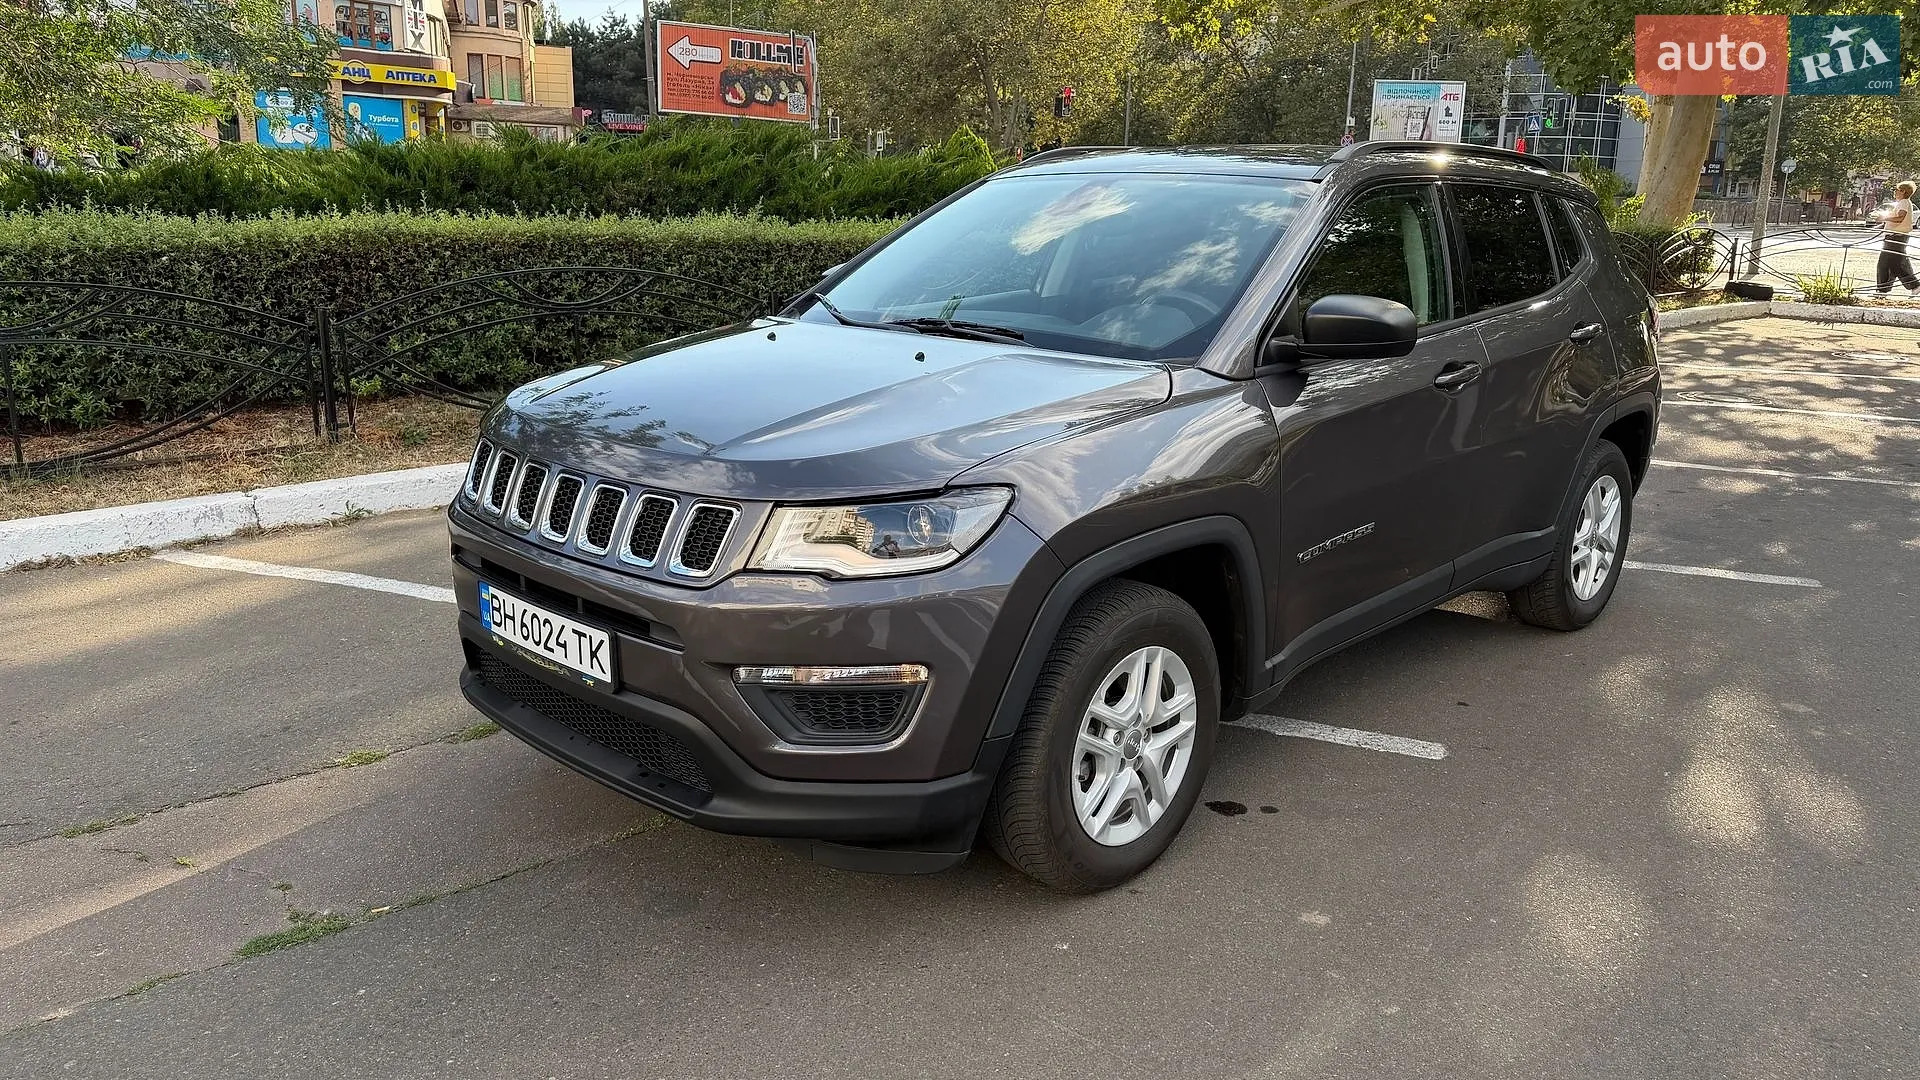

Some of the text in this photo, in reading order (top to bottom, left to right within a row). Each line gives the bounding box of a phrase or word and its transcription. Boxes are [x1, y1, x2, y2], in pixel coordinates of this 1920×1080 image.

[678, 47, 698, 57] 280
[341, 66, 437, 84] АНЦ АПТЕКА
[1440, 93, 1461, 101] АТБ
[368, 114, 399, 123] Турбота
[490, 592, 516, 636] BH
[520, 608, 568, 660] 6024
[571, 627, 607, 675] TK
